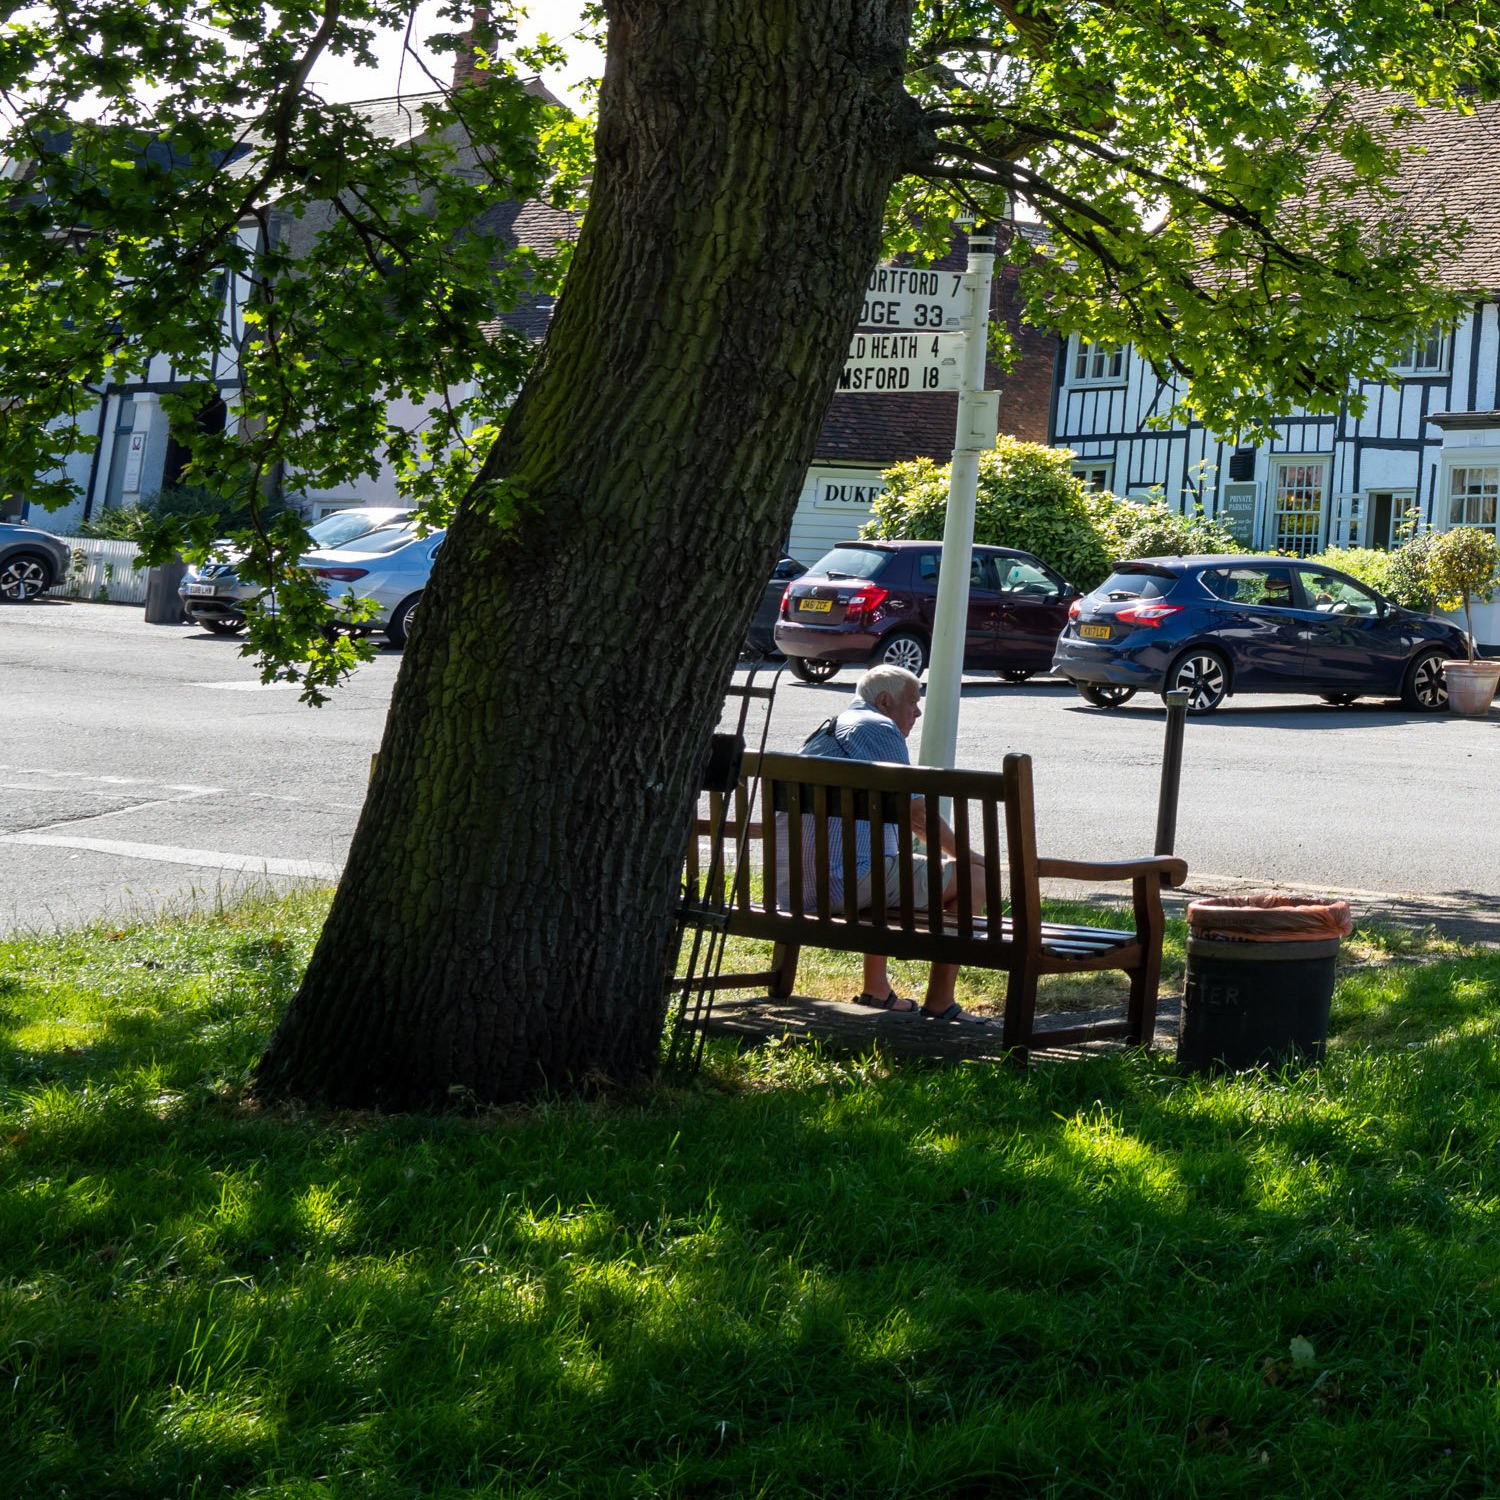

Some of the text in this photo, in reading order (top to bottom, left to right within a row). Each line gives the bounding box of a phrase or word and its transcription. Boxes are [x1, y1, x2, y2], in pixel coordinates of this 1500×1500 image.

[951, 275, 962, 297] 7
[914, 304, 943, 327] 33
[871, 336, 918, 359] HEATH
[931, 336, 939, 358] 4
[923, 367, 939, 388] 18
[1228, 503, 1253, 511] PARKING
[1229, 495, 1253, 503] PRIVATE
